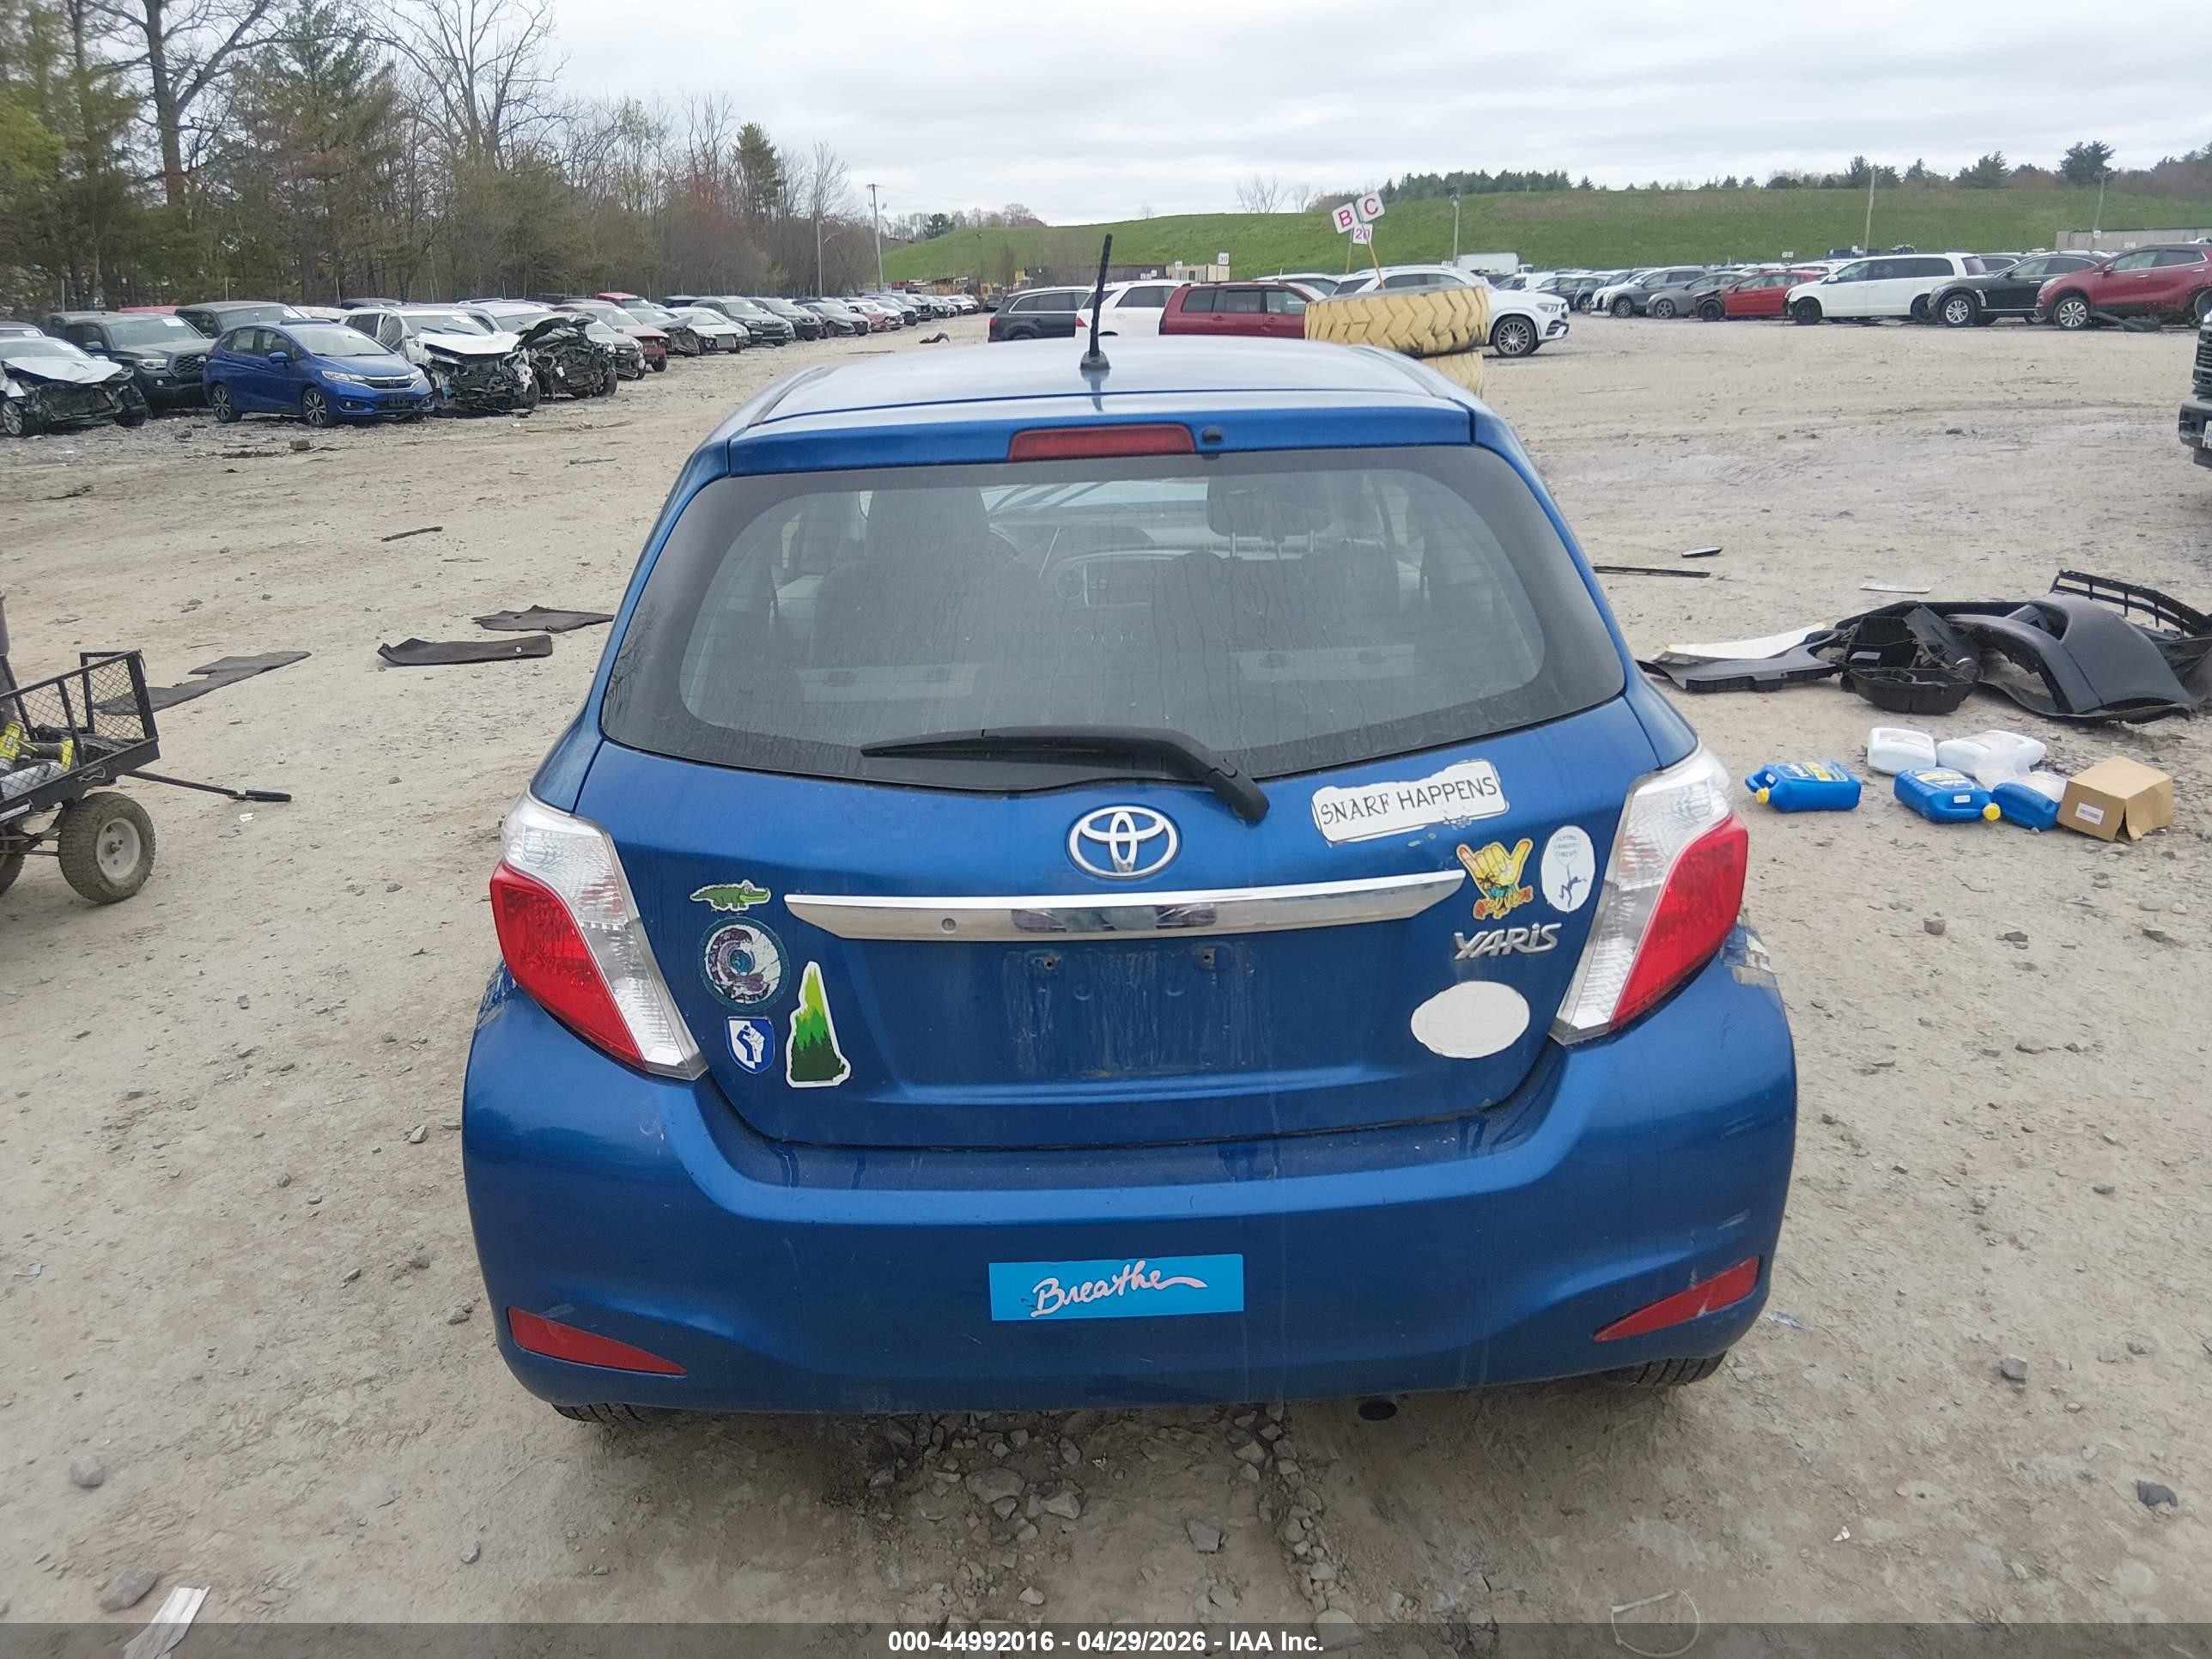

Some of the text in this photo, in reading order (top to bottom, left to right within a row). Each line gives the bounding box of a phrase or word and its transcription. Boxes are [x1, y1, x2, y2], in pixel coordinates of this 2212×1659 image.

[1338, 209, 1353, 228] B
[1364, 198, 1379, 216] C
[1320, 776, 1498, 825] SNARF HAPPENS
[1030, 1259, 1208, 1318] Breathe
